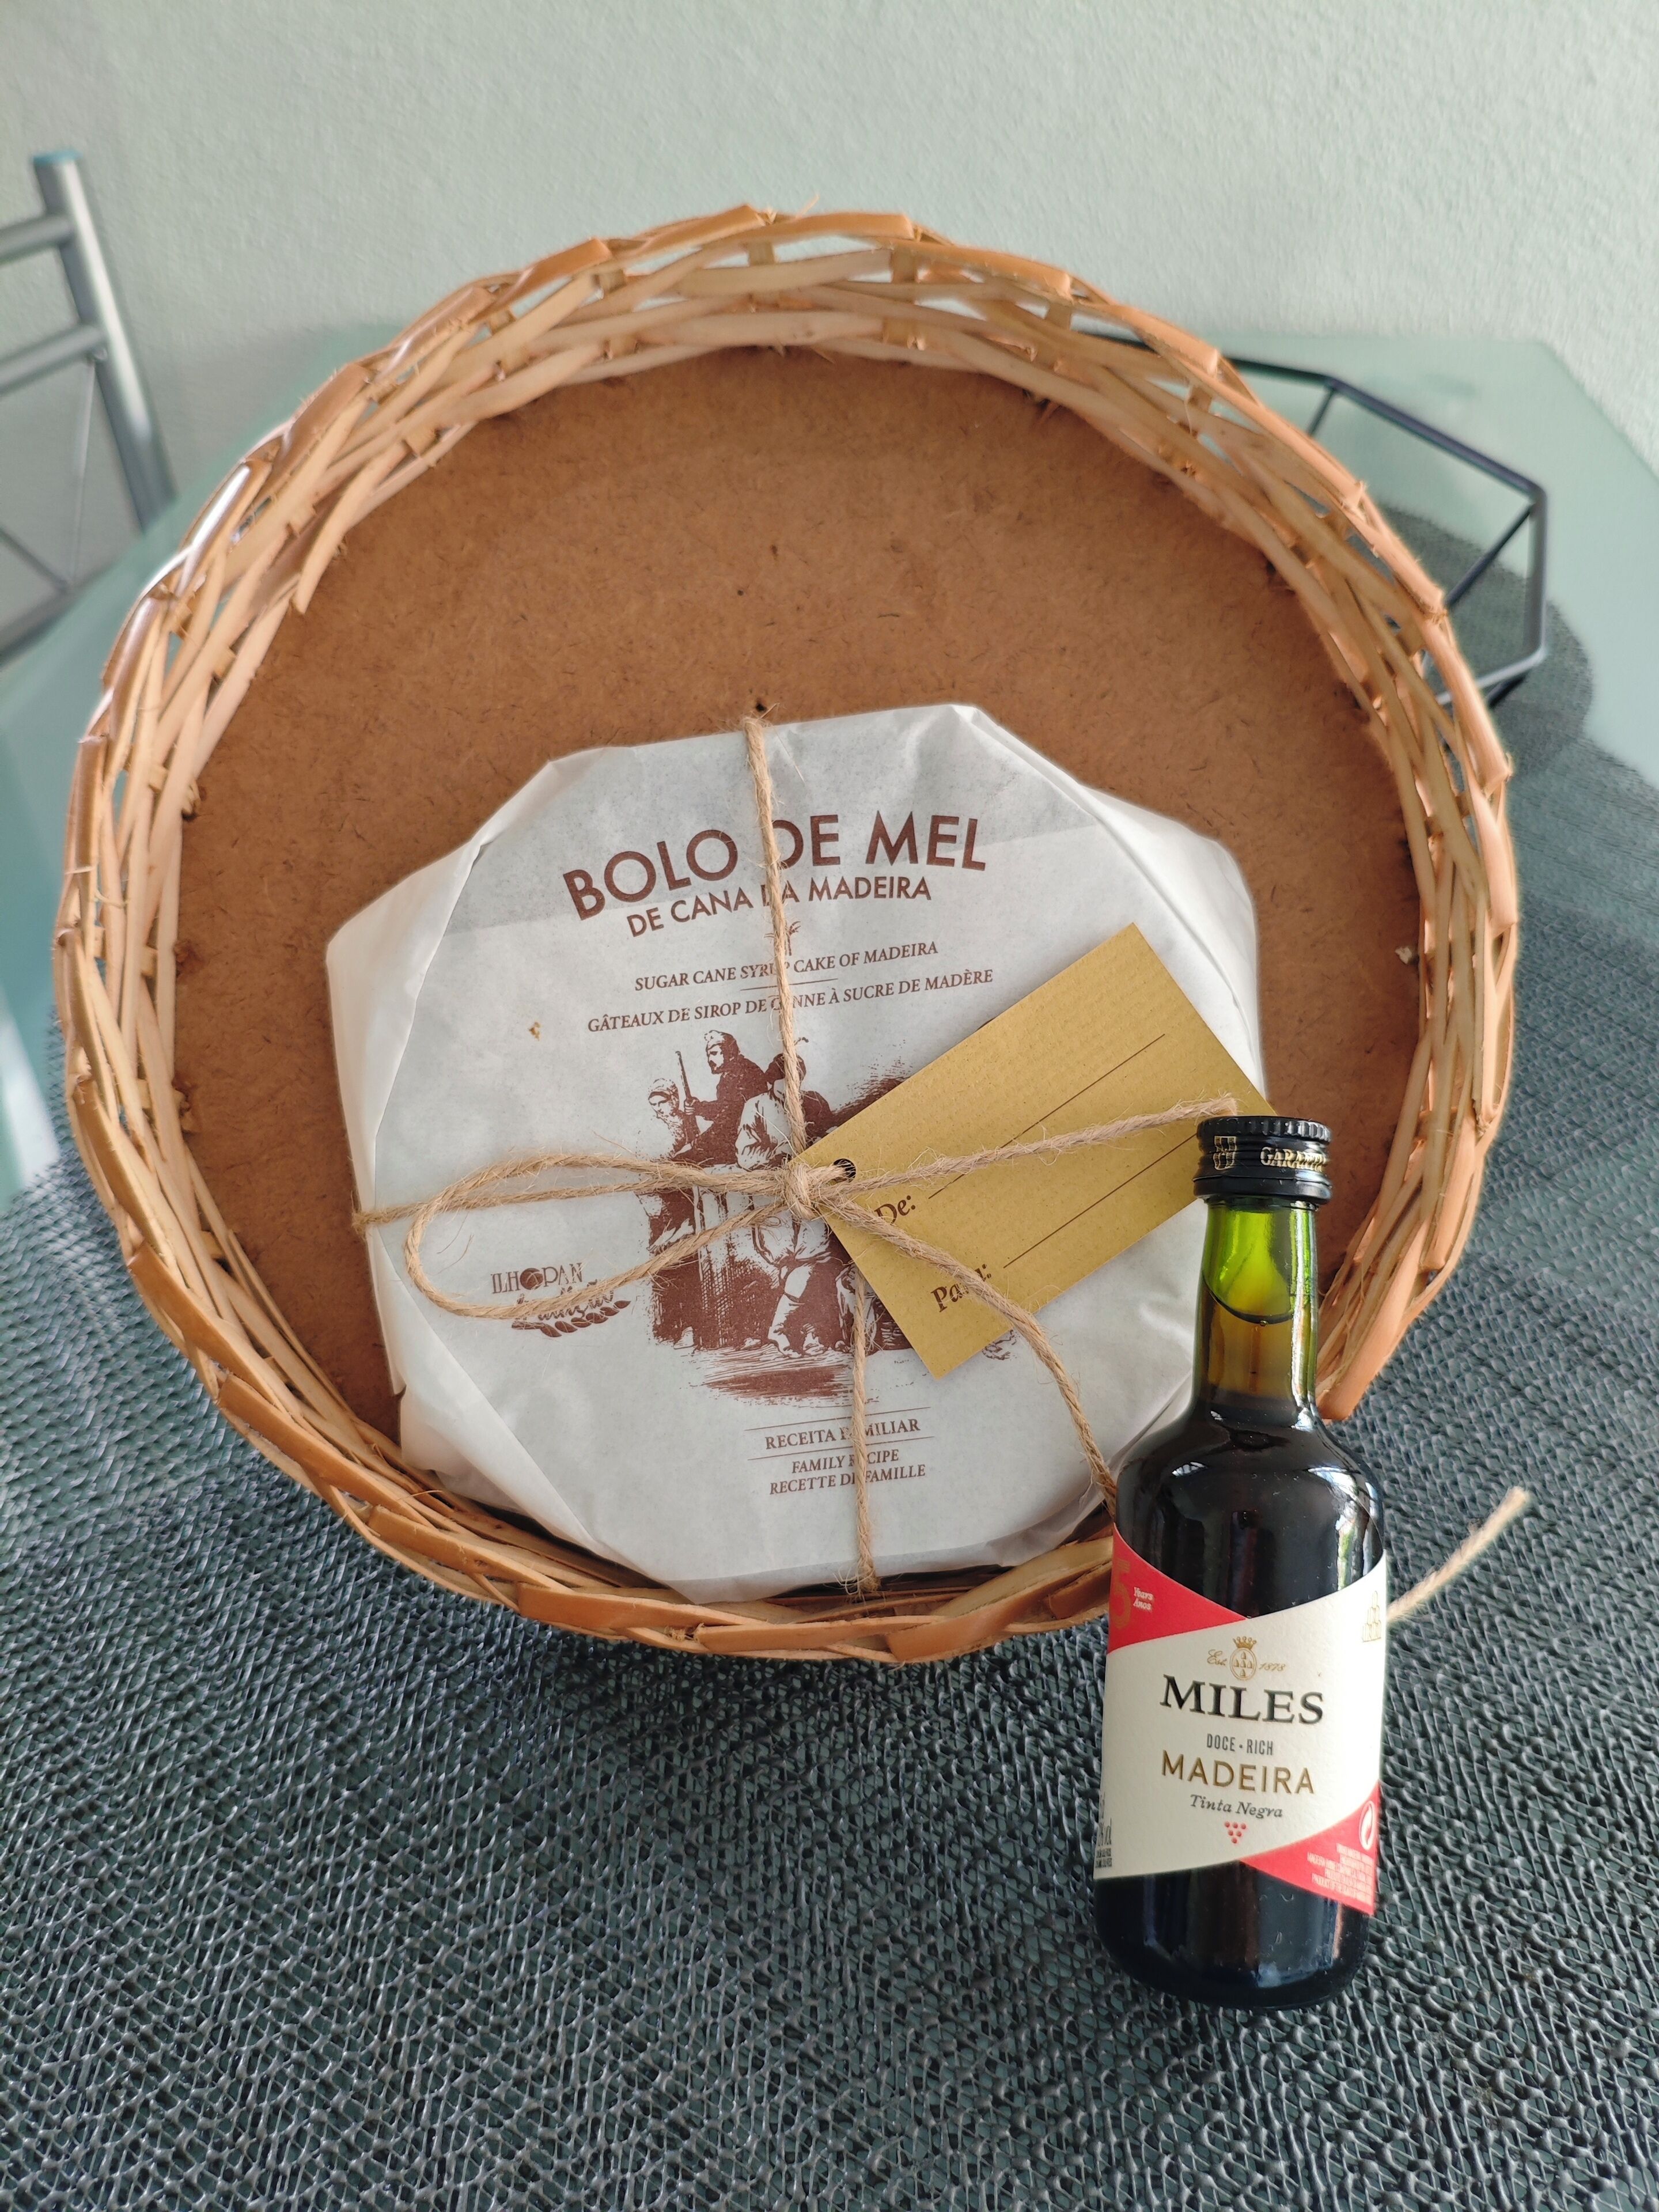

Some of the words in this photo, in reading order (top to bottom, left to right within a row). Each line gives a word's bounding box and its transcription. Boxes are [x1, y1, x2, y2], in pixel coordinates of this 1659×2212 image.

[563, 829, 738, 921] BOLO
[770, 814, 841, 870] DE
[865, 810, 986, 871] MEL
[627, 907, 664, 938] DE
[671, 887, 753, 923] CANA
[808, 876, 931, 902] MADEIRA
[635, 972, 690, 991] SUGAR
[693, 967, 737, 984] CANE
[794, 956, 836, 974] CAKE
[839, 952, 860, 968] OF
[863, 941, 938, 964] MADEIRA
[588, 1010, 664, 1032] GÂTEAUX
[668, 1007, 690, 1024] DE
[694, 1002, 741, 1020] SIROP
[745, 998, 767, 1014] DE
[770, 992, 825, 1012] CNNE
[828, 987, 840, 1004] À
[843, 982, 895, 1002] SUCRE
[898, 979, 921, 995] DE
[924, 968, 994, 991] MADÈRE
[874, 1195, 916, 1226] De:
[765, 1428, 837, 1450] RECEITA
[839, 1418, 921, 1441] FMILIAR
[769, 1474, 836, 1495] RECETTE
[865, 1464, 926, 1483] FAMILLE
[792, 1455, 846, 1474] FAMILY
[849, 1449, 900, 1467] RCIPE
[1159, 1673, 1324, 1725] MILES
[1206, 1733, 1236, 1752] DOCE
[1246, 1738, 1274, 1756] RICH
[1161, 1749, 1315, 1794] MADEIRA
[1190, 1794, 1232, 1813] Tinta
[1235, 1801, 1283, 1819] Negra
